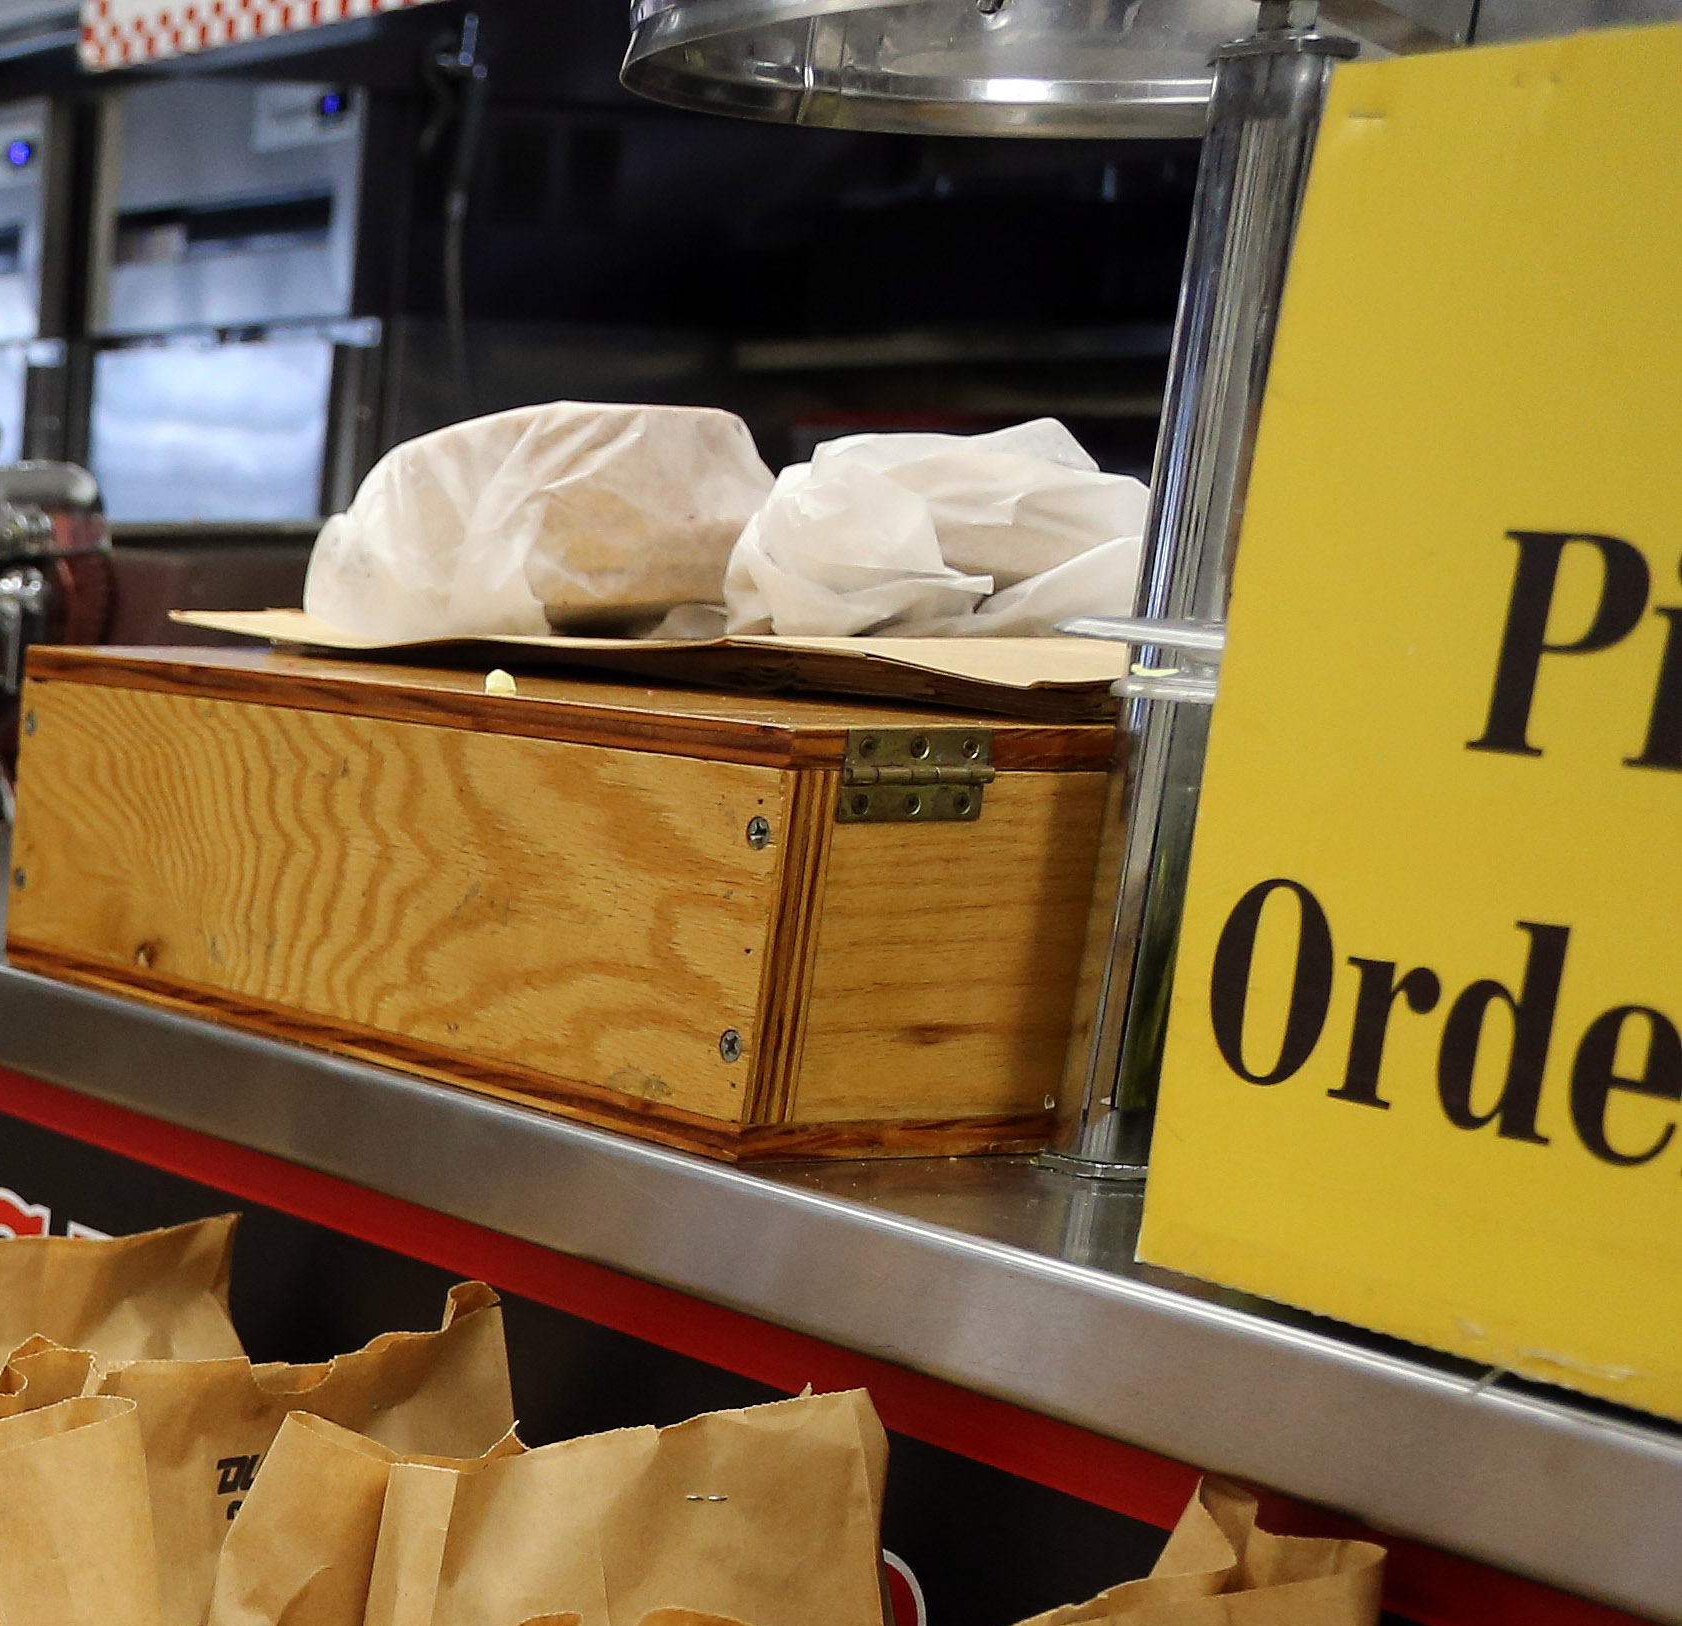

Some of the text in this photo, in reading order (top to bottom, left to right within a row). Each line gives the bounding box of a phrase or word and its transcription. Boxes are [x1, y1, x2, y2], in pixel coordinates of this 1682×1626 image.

[1465, 531, 1682, 772] Pi
[1208, 877, 1682, 1168] Orde
[216, 1454, 261, 1495] DU
